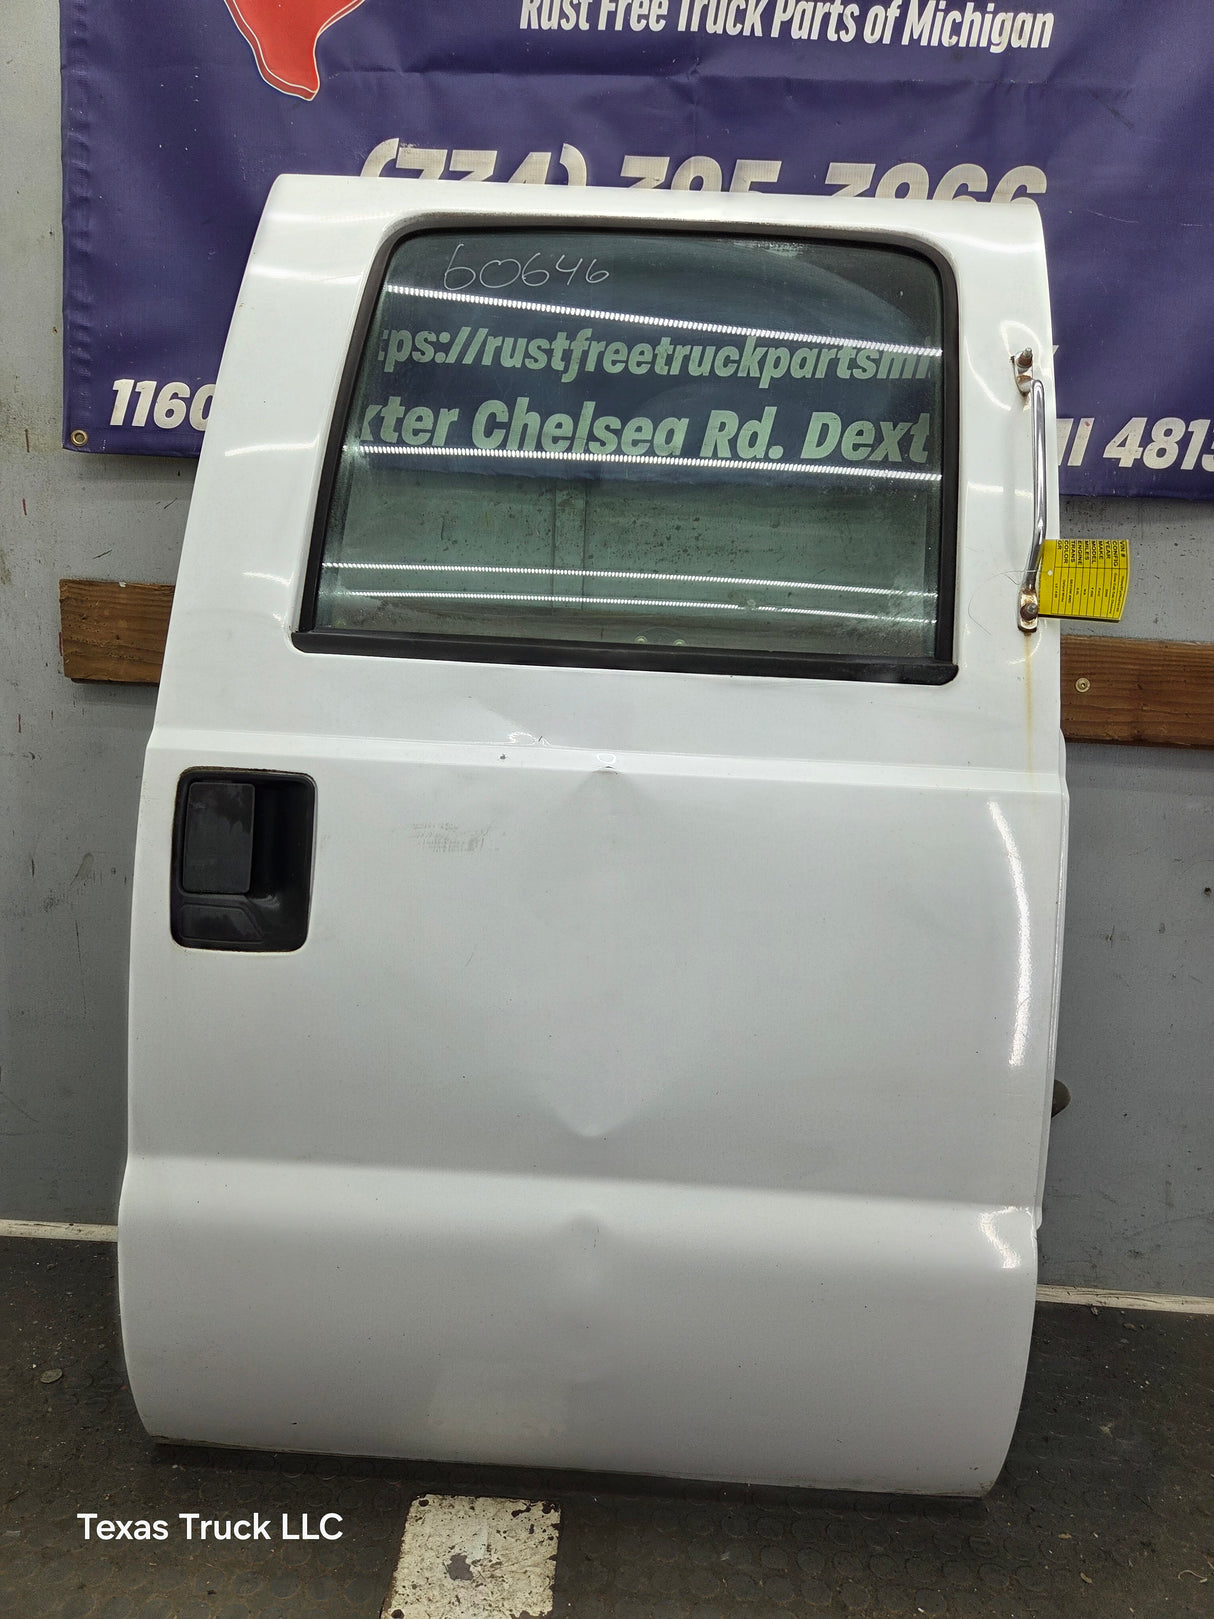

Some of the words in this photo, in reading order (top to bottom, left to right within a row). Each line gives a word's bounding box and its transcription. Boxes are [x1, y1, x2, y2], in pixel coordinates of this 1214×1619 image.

[519, 0, 593, 30] Rust
[598, 0, 668, 32] Free
[770, 0, 860, 43] Parts
[863, 0, 900, 45] of
[901, 0, 1055, 53] Michigan
[443, 243, 610, 291] 60646
[472, 397, 690, 456] Chelsea
[700, 406, 784, 460] Rd.
[800, 411, 931, 464] Dext
